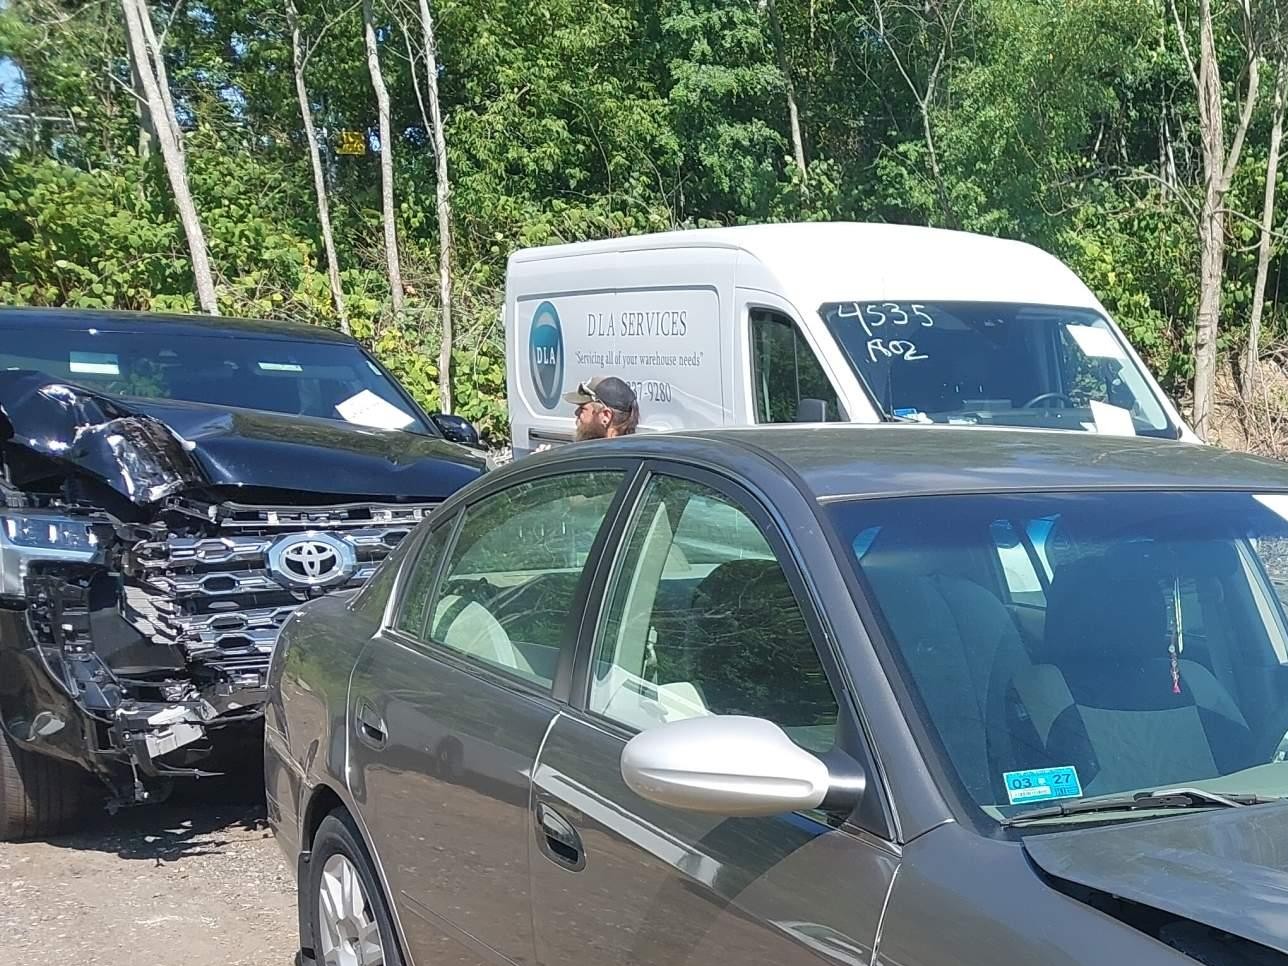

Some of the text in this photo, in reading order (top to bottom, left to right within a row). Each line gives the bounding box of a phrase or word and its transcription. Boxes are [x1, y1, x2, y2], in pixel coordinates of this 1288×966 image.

[587, 311, 687, 336] DLA SERVICES
[838, 302, 934, 336] 4535
[536, 347, 556, 365] DLA
[605, 351, 613, 365] all
[614, 351, 622, 365] of
[623, 355, 638, 368] your
[639, 351, 677, 366] warehouse
[626, 381, 672, 402] 37-9280
[1012, 778, 1032, 789] 03
[1052, 773, 1072, 784] 27
